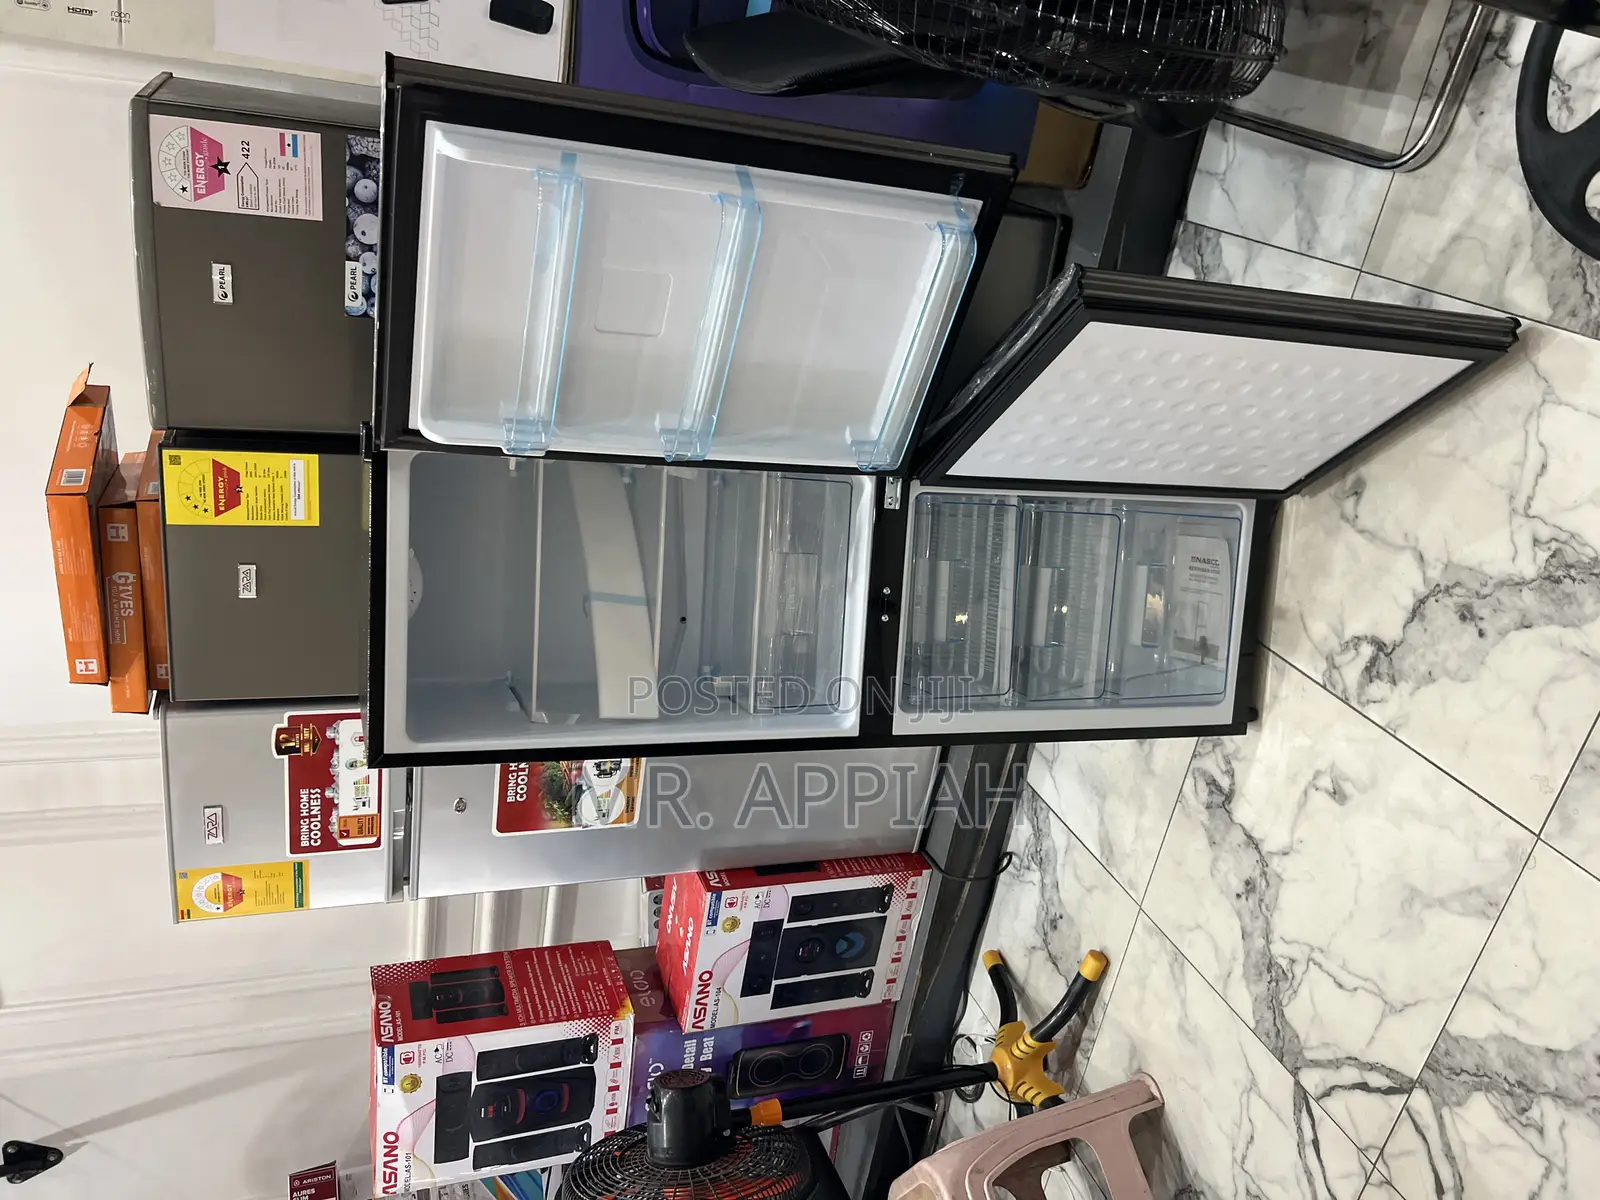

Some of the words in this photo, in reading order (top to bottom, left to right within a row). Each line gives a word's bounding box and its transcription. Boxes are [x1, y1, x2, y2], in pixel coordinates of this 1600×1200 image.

[110, 10, 131, 19] roon
[241, 140, 250, 160] 422
[194, 152, 208, 194] ENERGY
[218, 267, 226, 290] PEARL
[218, 476, 226, 510] ENERGY
[112, 572, 136, 616] GIVES
[507, 773, 518, 802] BRING
[300, 788, 309, 816] HOME
[207, 813, 217, 840] ZARA
[310, 788, 321, 846] COOLNESS
[300, 819, 310, 847] BRING
[755, 899, 761, 908] AC
[764, 899, 771, 908] DC
[682, 917, 694, 976] ASANO
[503, 951, 512, 970] SYSTEM
[508, 970, 516, 988] SPEAKER
[512, 989, 521, 1014] MULTIMEDIA
[692, 970, 713, 1030] ASANO
[710, 987, 722, 1028] MODEL:AS-104
[378, 1001, 394, 1042] ASANO
[615, 1025, 620, 1035] FM
[435, 1054, 442, 1064] AC
[446, 1052, 453, 1062] DC
[682, 1039, 697, 1070] Detail
[700, 1036, 715, 1061] Beat
[382, 1132, 399, 1194] ASANO
[302, 1174, 331, 1184] ARISTON
[293, 1188, 316, 1197] AURES
